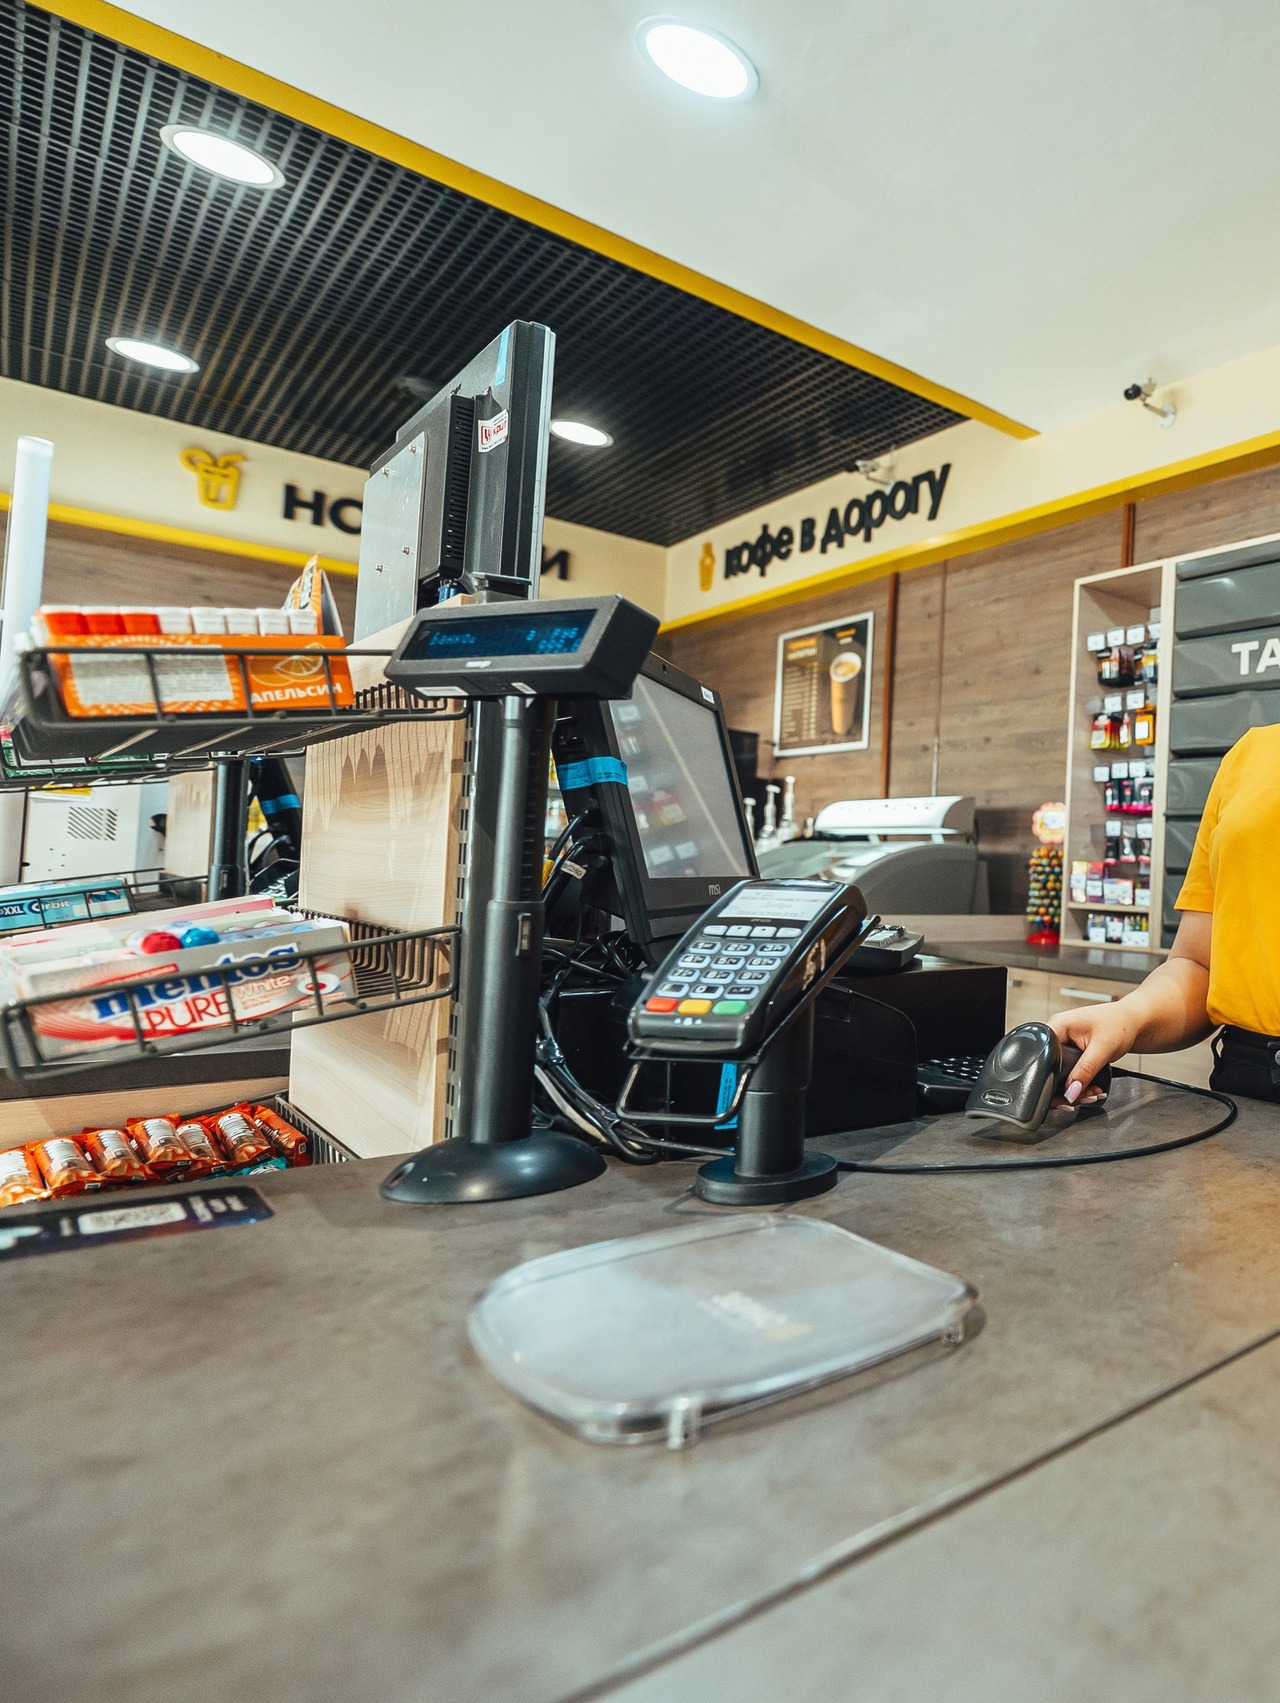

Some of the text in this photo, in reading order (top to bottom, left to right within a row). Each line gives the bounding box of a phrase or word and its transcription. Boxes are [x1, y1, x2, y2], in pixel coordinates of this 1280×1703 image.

[724, 463, 951, 579] кофе в дорогу
[249, 682, 343, 704] АПЕЛЬСИН
[31, 899, 70, 912] Orbit
[144, 989, 233, 1033] PURE
